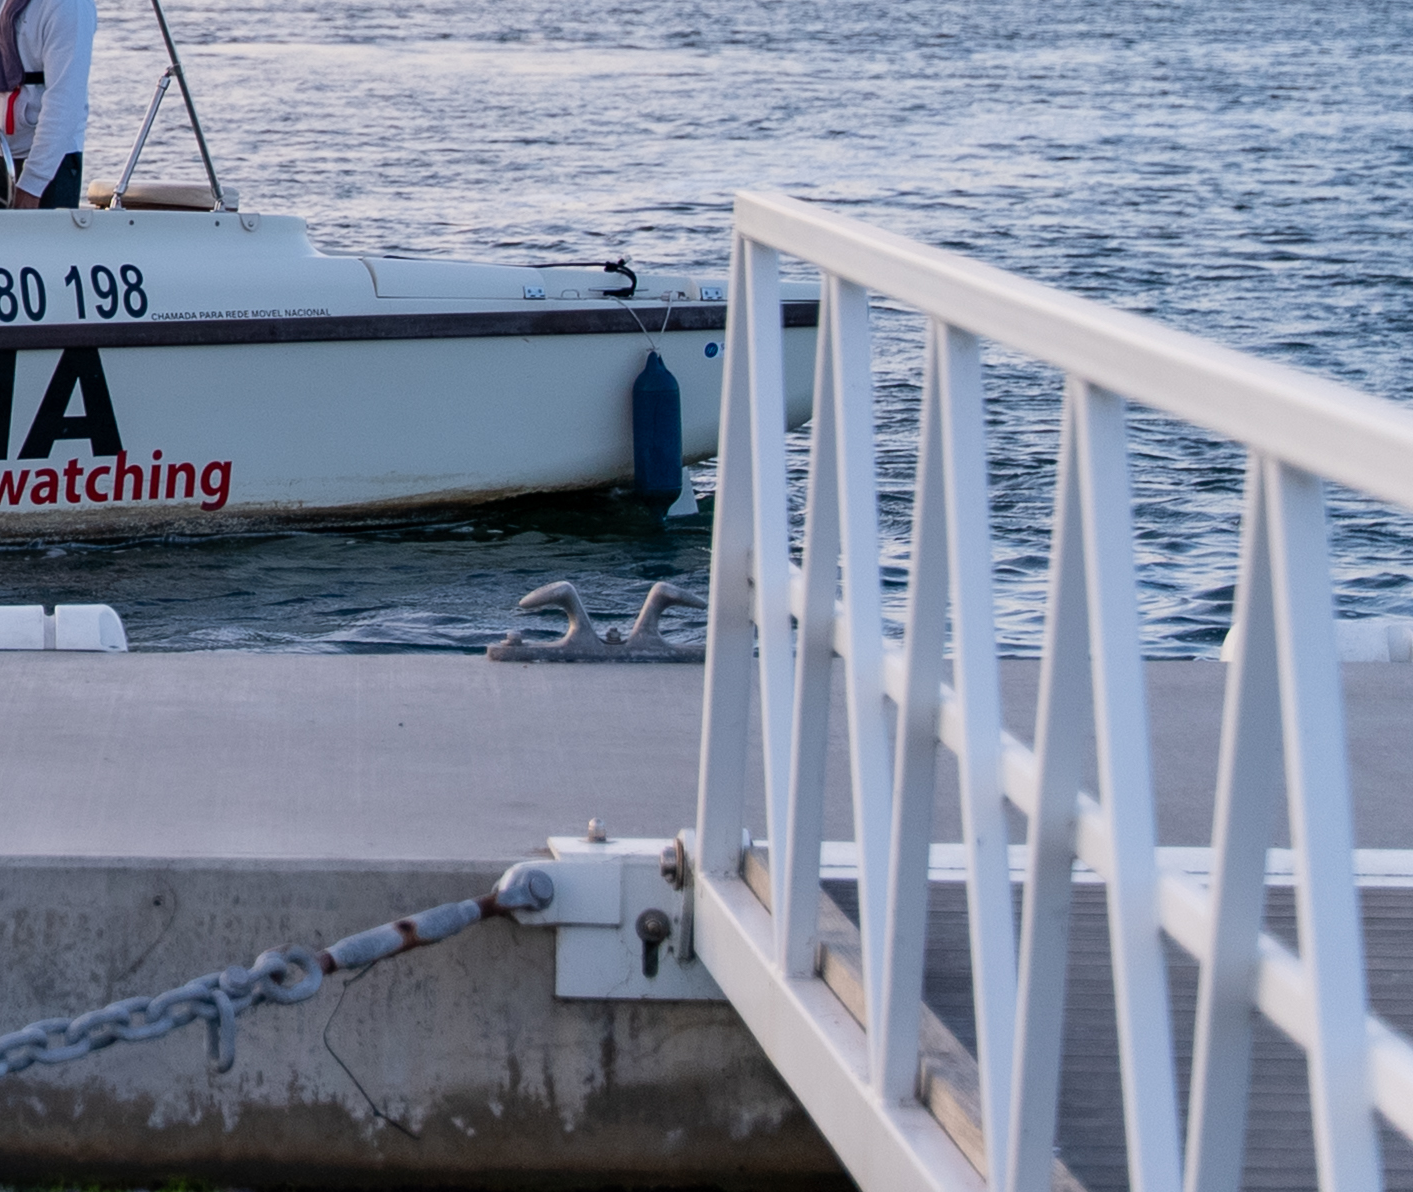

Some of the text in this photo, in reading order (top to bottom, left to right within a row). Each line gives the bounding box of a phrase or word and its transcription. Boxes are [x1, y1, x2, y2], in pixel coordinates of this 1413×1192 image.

[64, 263, 149, 319] 198
[151, 311, 197, 321] CHAMADA
[199, 310, 224, 319] PARA
[225, 309, 250, 319] REDE
[284, 308, 332, 317] NACIONAL
